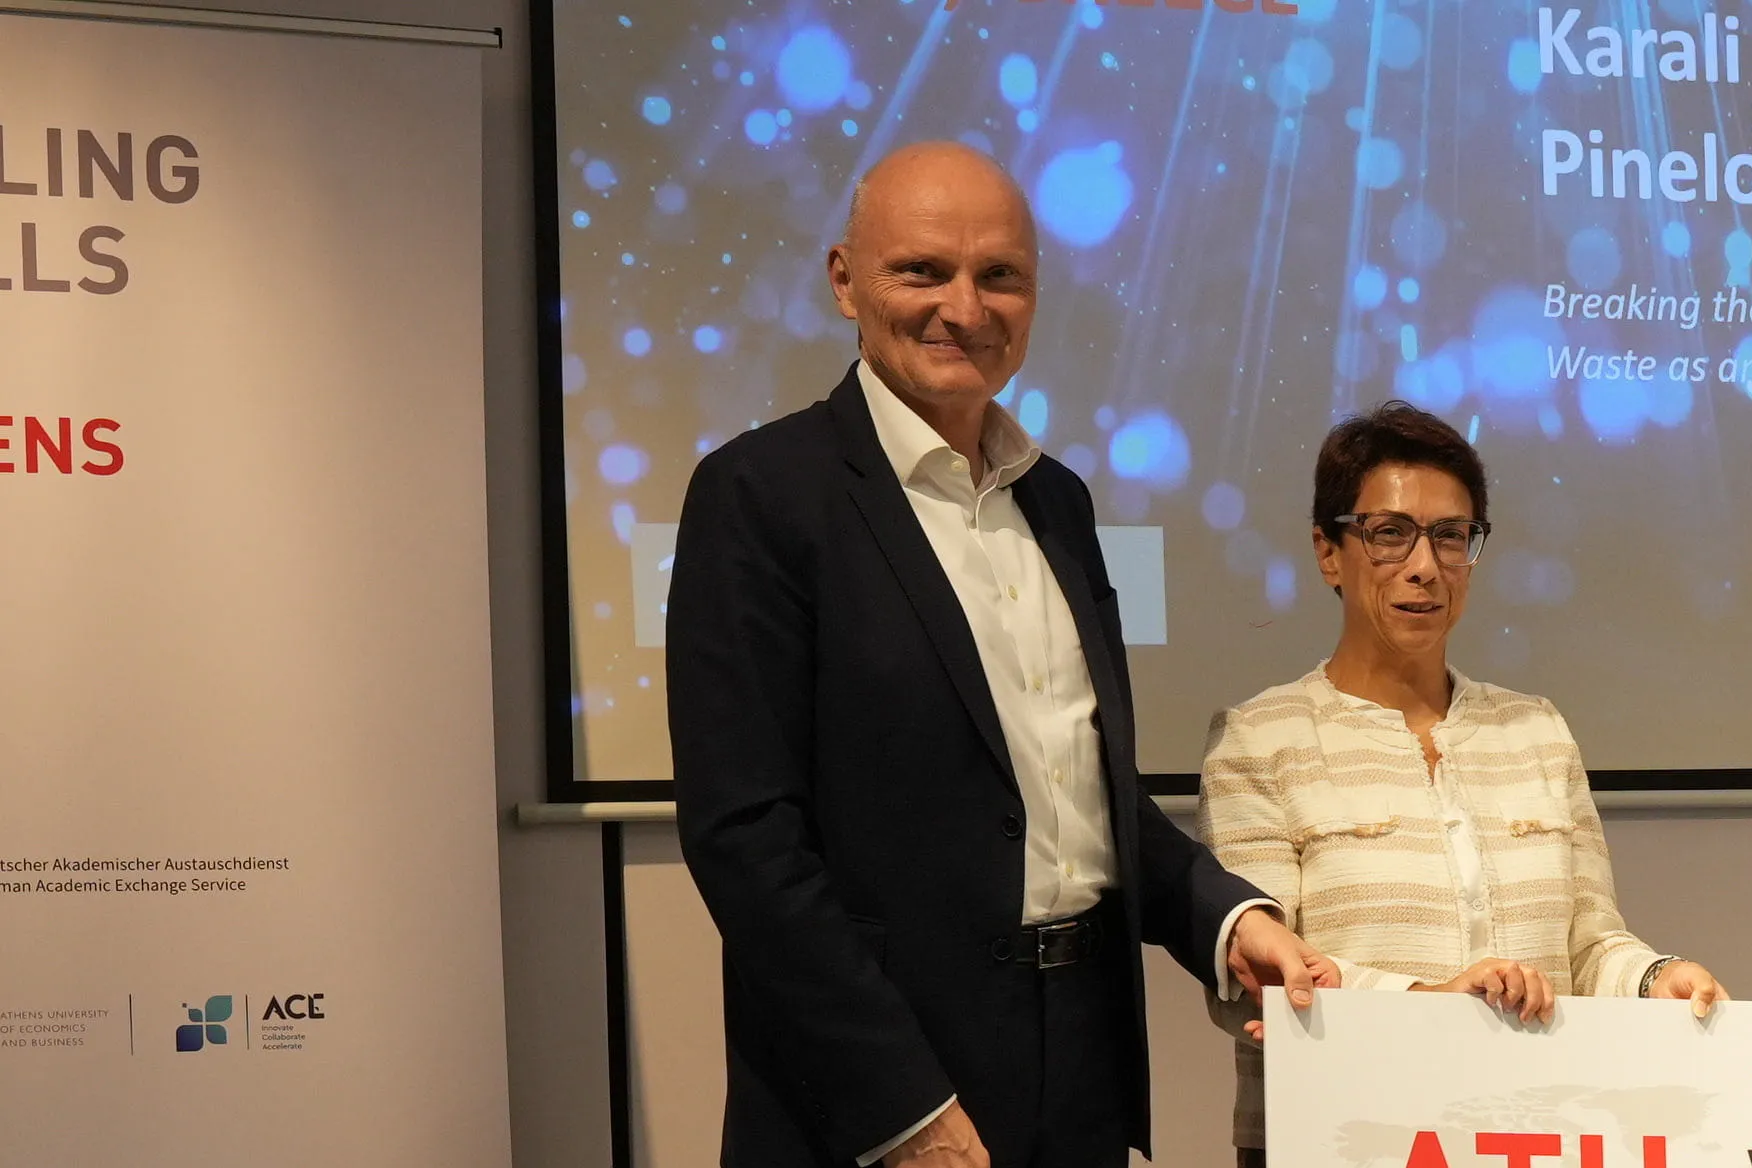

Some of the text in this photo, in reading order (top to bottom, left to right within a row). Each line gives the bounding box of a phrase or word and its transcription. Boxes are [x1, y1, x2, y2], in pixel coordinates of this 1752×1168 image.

[1538, 7, 1740, 83] Karali
[0, 125, 200, 204] LING
[1543, 283, 1701, 331] Breaking
[1547, 345, 1657, 382] Waste
[1668, 355, 1708, 383] as
[0, 415, 125, 476] ENS
[0, 856, 289, 872] tscher Akademischer Austauschdienst
[0, 877, 246, 895] man Academic Exchange Service
[0, 1009, 110, 1020] ATHENS UNIVERSITY
[262, 993, 325, 1020] ACE
[0, 1023, 86, 1034] OF ECONOMICS
[261, 1024, 294, 1032] Innovate
[1, 1037, 84, 1047] AND BUSINESS
[261, 1033, 306, 1041] Collaborate
[262, 1042, 303, 1050] Accelerate
